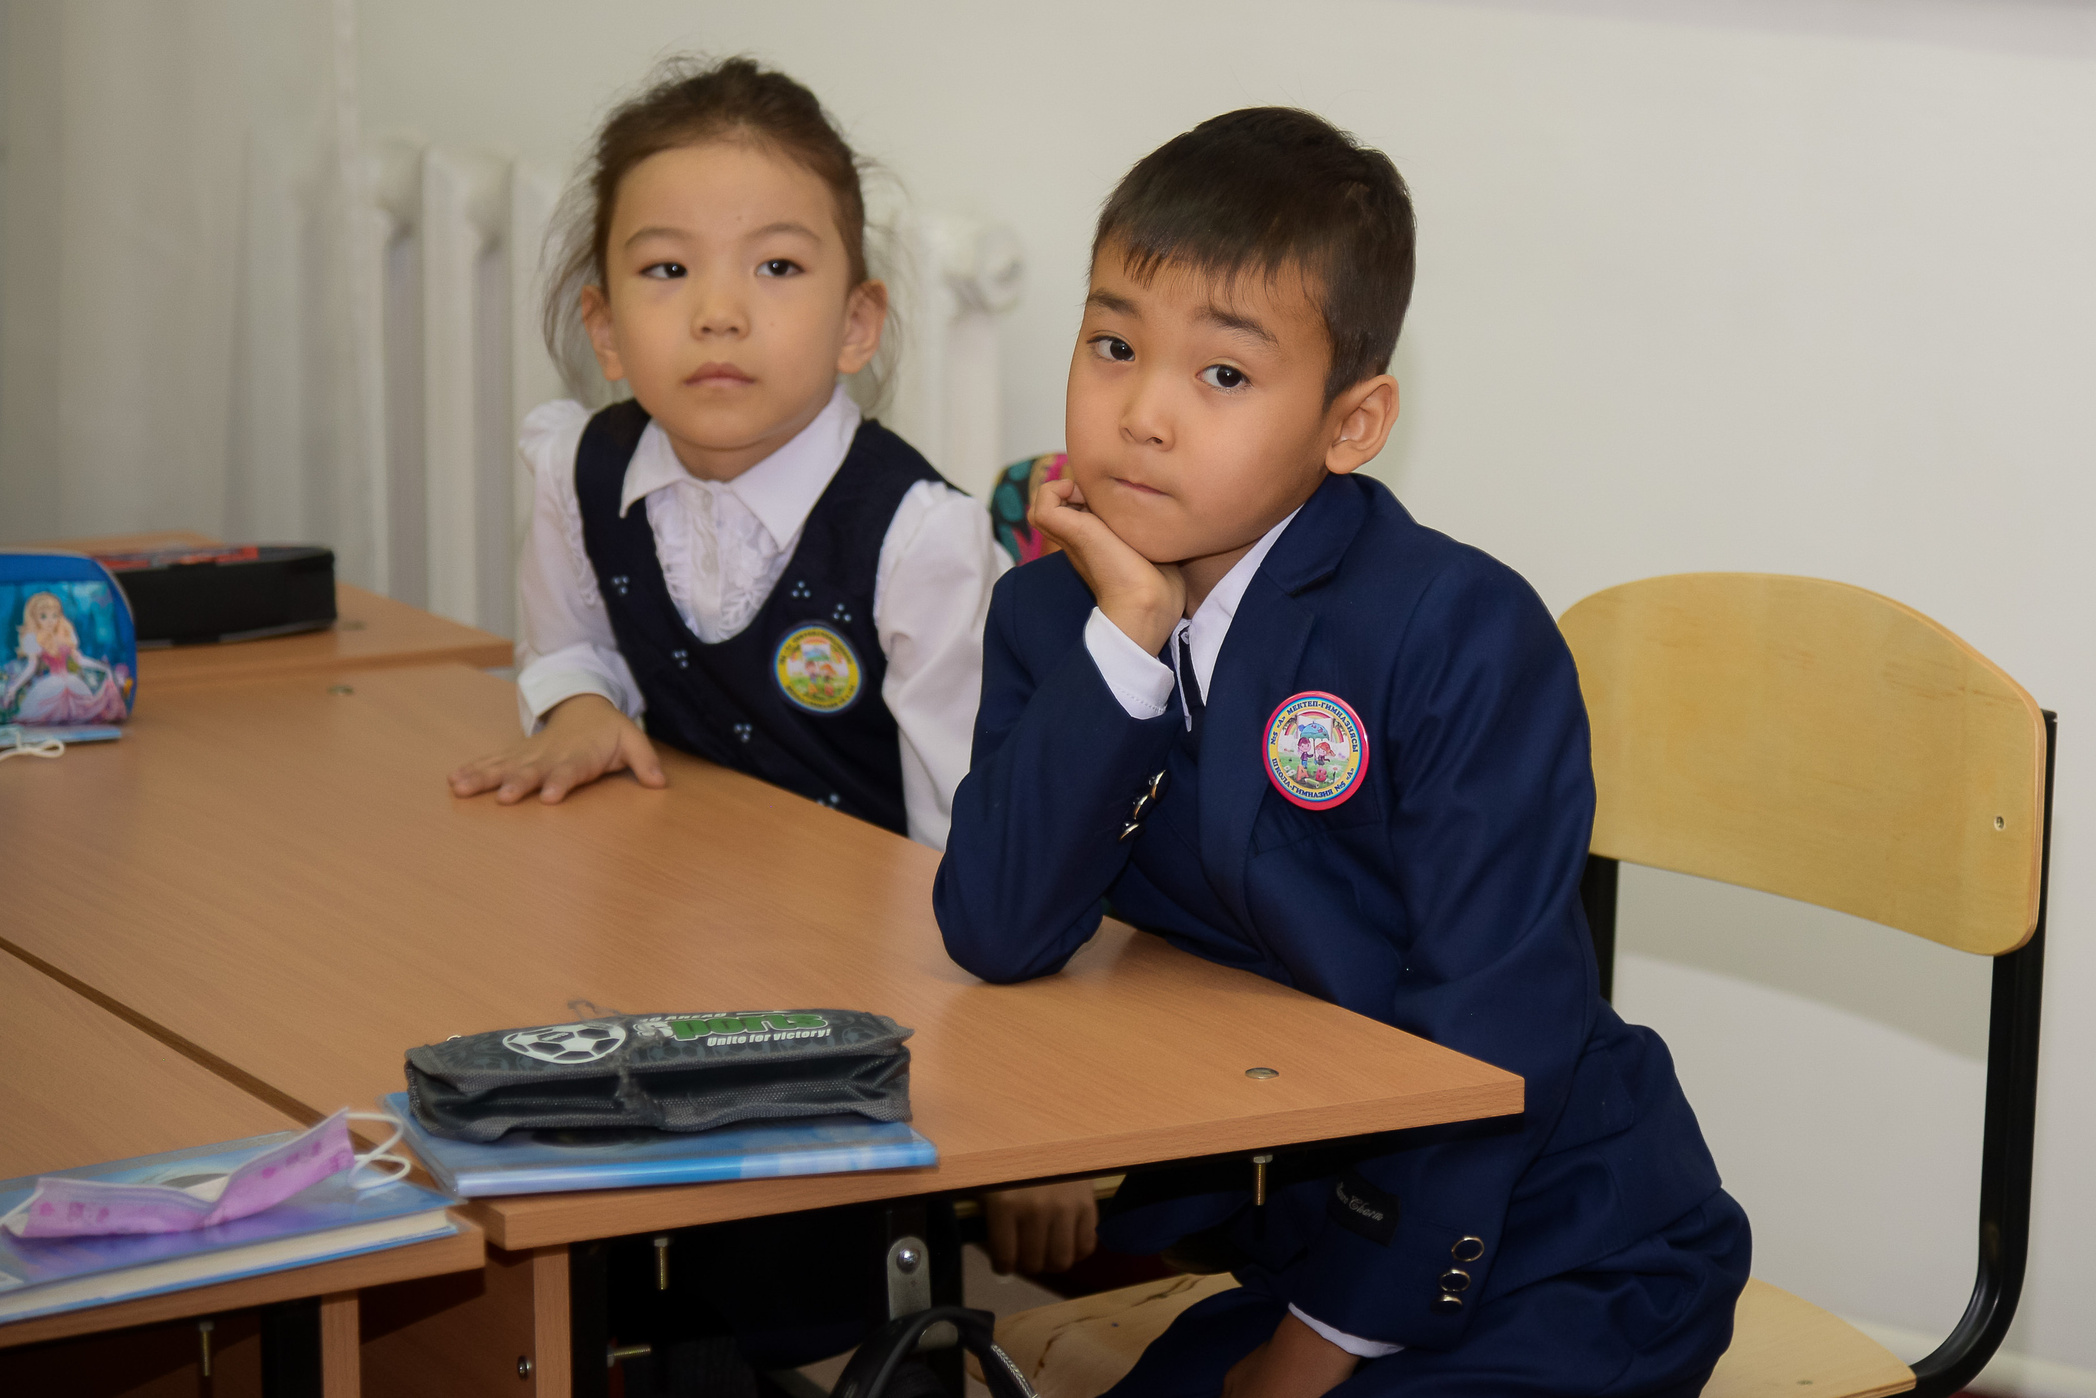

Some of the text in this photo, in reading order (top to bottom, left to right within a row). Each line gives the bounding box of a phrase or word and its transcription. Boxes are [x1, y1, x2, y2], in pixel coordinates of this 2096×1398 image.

[1272, 758, 1333, 798] ШКОЛА-ГИМНАЗИЯ
[749, 1033, 771, 1043] for
[773, 1028, 831, 1041] victory!
